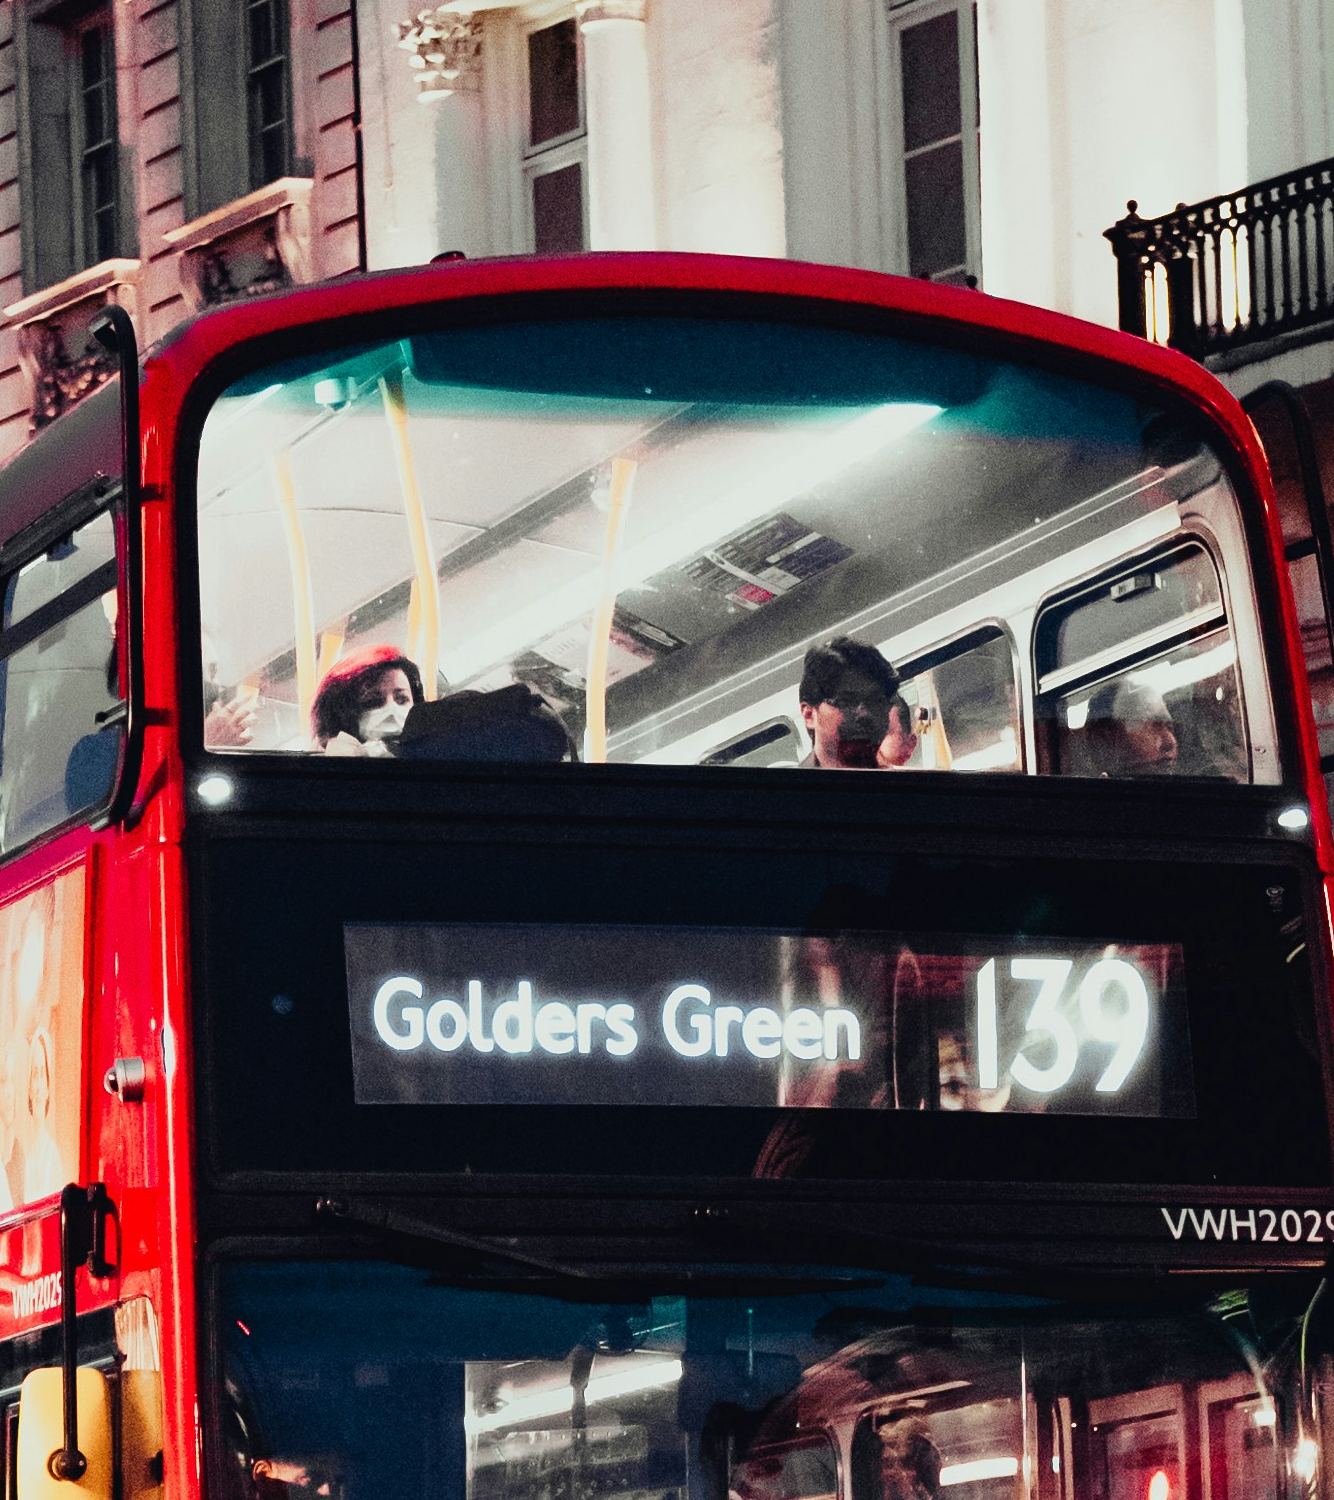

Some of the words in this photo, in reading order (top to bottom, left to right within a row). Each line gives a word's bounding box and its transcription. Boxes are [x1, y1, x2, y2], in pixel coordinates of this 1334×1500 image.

[373, 976, 638, 1056] Golders
[662, 982, 861, 1060] Green
[973, 957, 1153, 1093] 139
